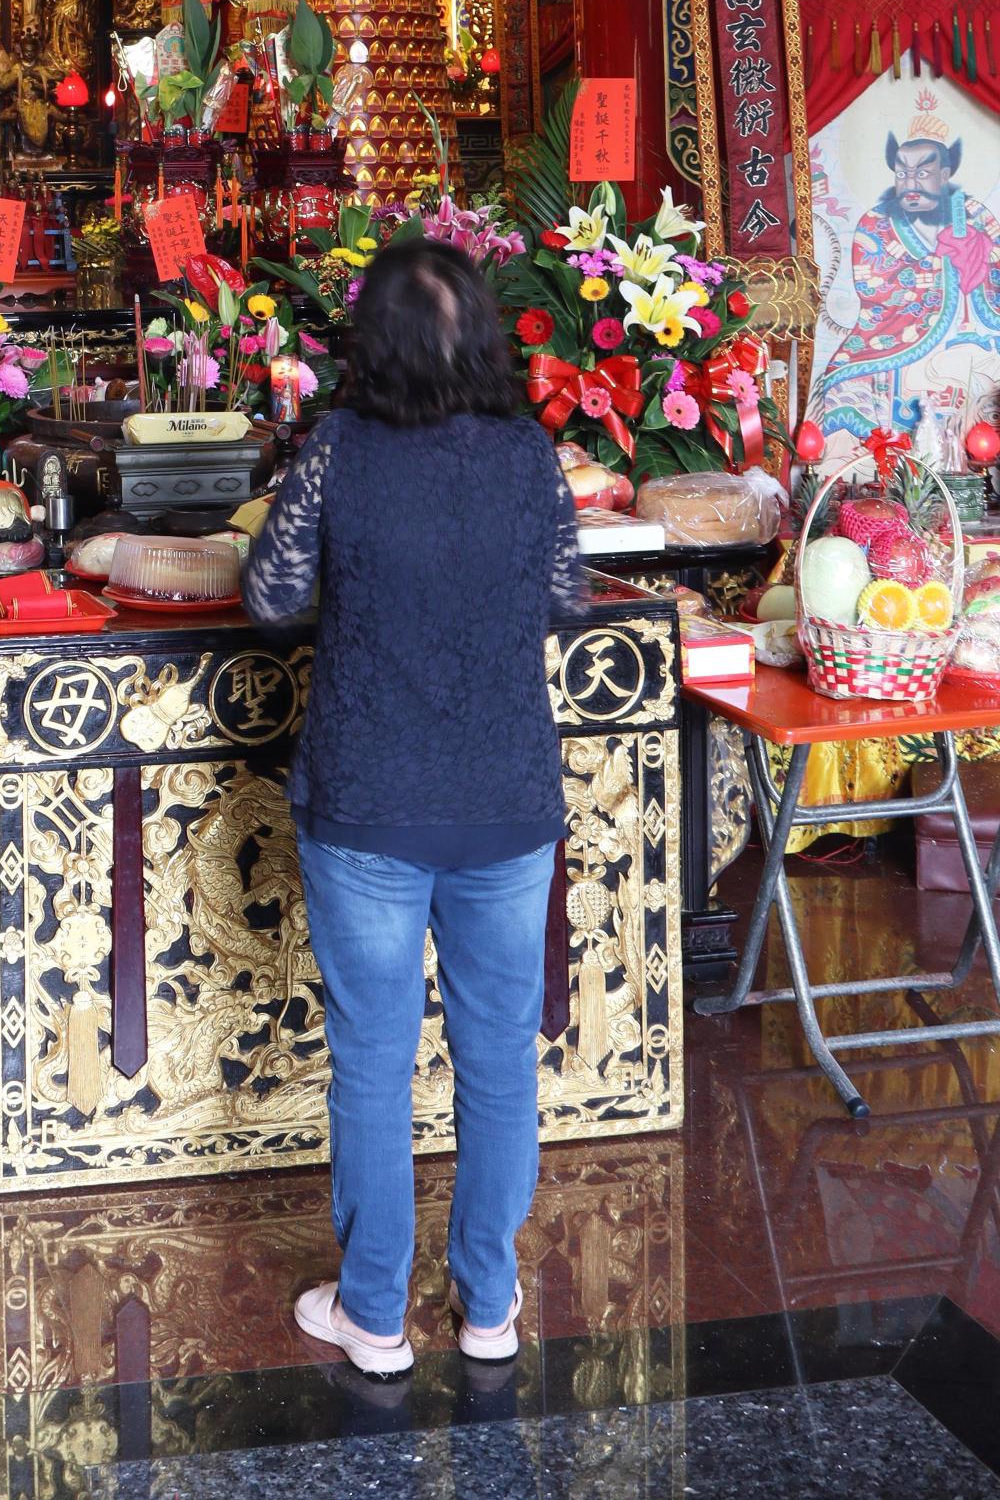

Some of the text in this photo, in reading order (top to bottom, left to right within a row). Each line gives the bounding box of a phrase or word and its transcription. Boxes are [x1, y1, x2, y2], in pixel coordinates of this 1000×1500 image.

[595, 91, 611, 164] 聖誕千秋
[166, 419, 208, 432] Milano
[32, 635, 636, 746] 天 聖 母
